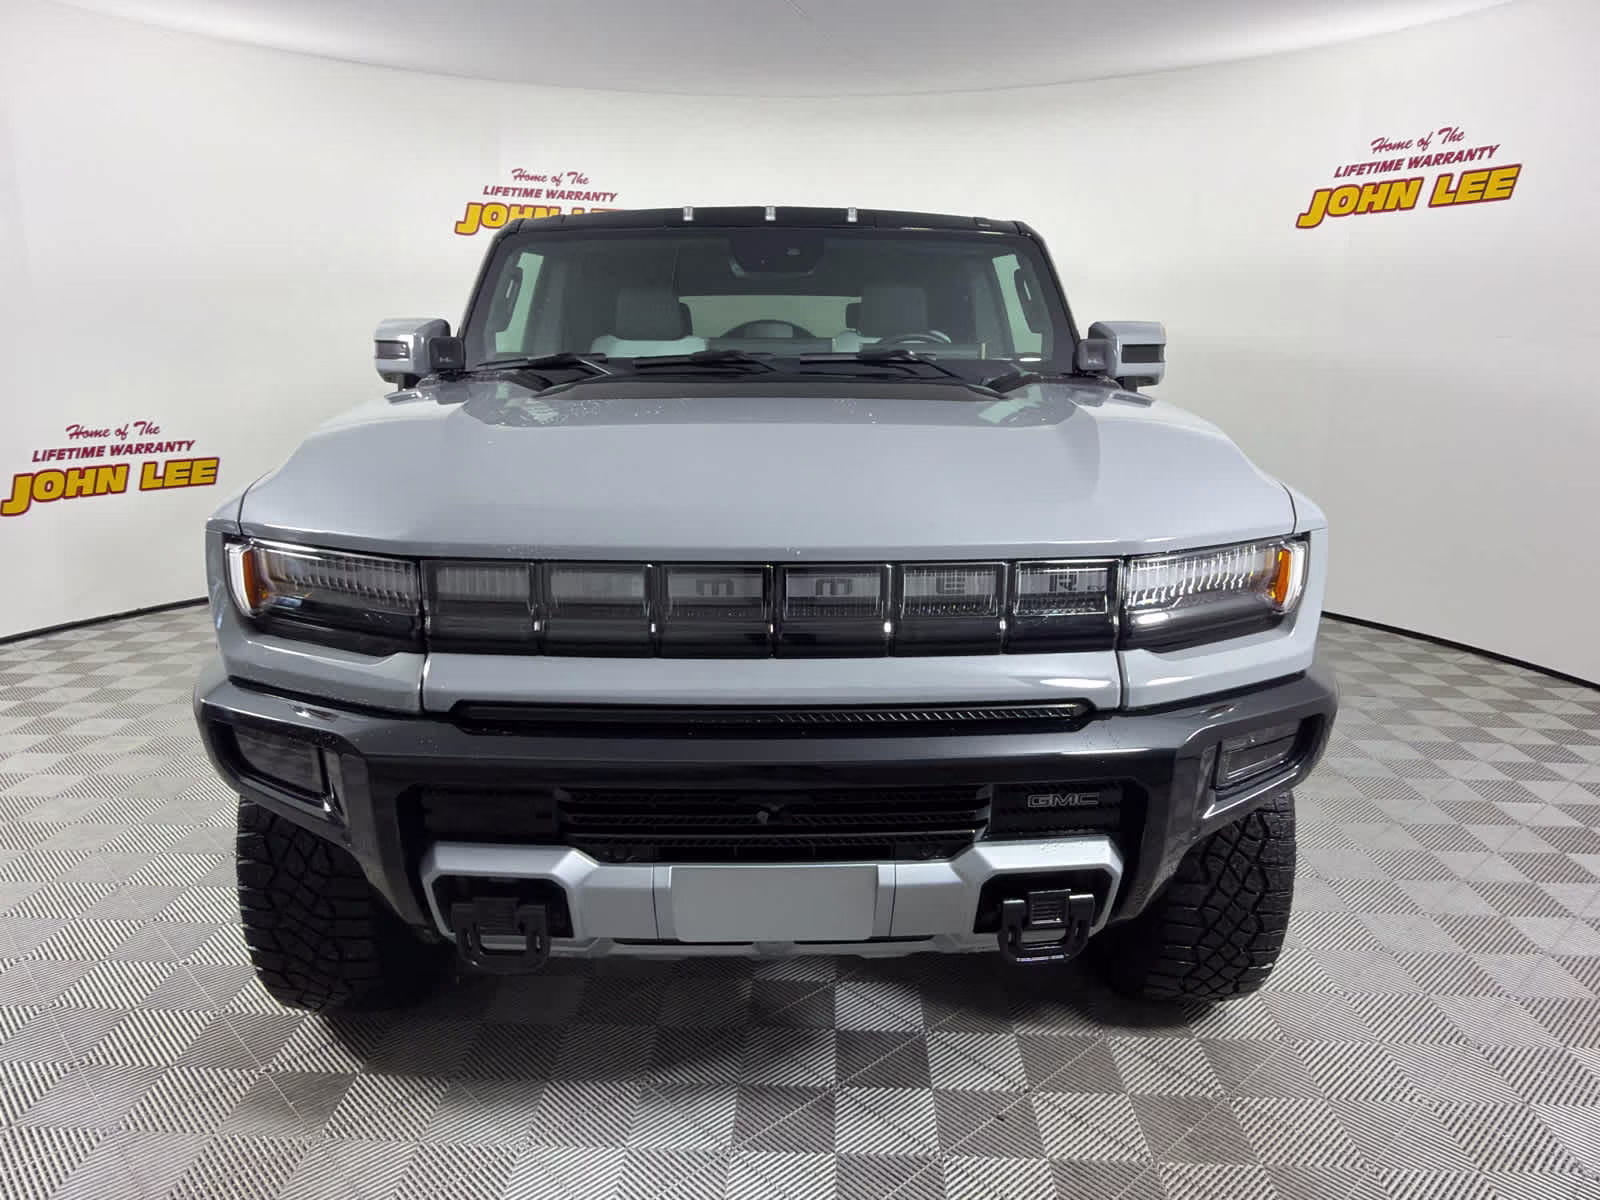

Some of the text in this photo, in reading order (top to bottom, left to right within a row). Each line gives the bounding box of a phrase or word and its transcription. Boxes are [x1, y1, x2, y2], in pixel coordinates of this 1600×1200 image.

[1370, 126, 1465, 154] Home of The
[1333, 144, 1501, 178] LIFETIME WARRANTY
[511, 168, 590, 187] Home of The
[482, 185, 618, 202] LIFETIME WARRANTY
[1296, 163, 1522, 229] JOHN LEE
[65, 420, 161, 441] Home of The
[32, 440, 196, 463] LIFETIME WARRANTY
[0, 457, 220, 517] JOHN LEE
[1027, 791, 1100, 808] GMC
